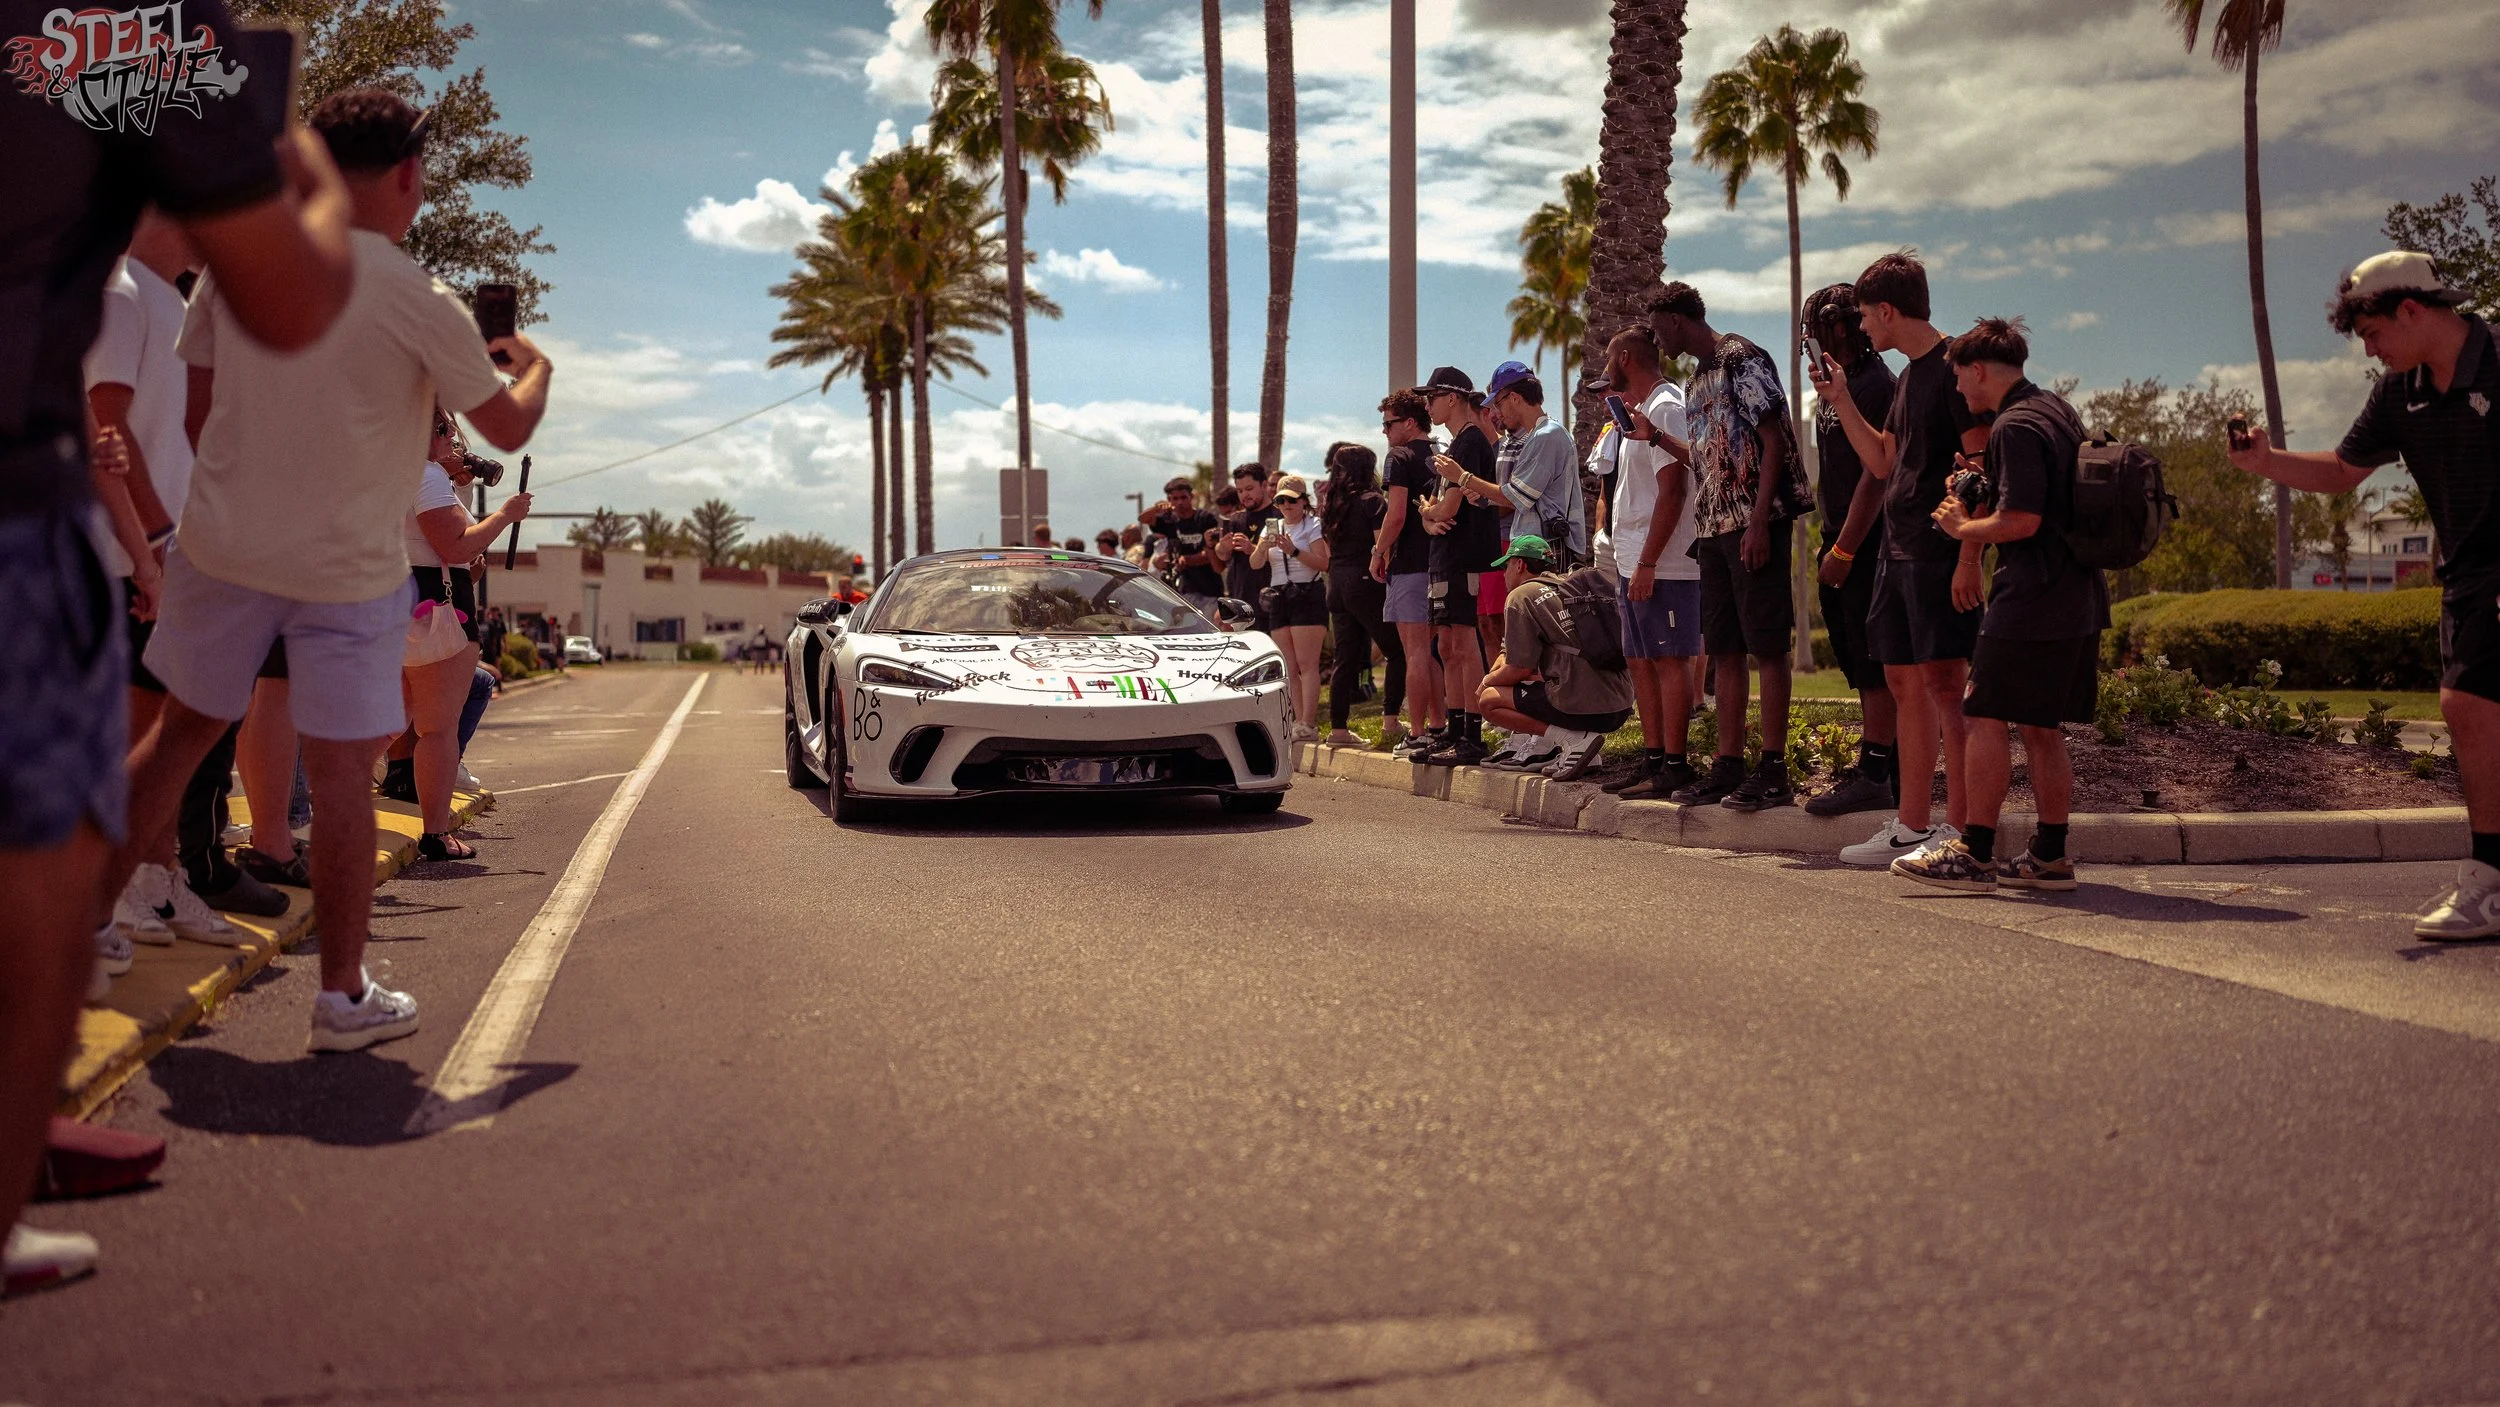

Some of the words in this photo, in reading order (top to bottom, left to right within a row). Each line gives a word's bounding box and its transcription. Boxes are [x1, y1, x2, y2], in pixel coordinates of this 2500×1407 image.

[962, 671, 1012, 687] Rock
[1176, 669, 1223, 684] Hard
[1112, 675, 1178, 705] MEX
